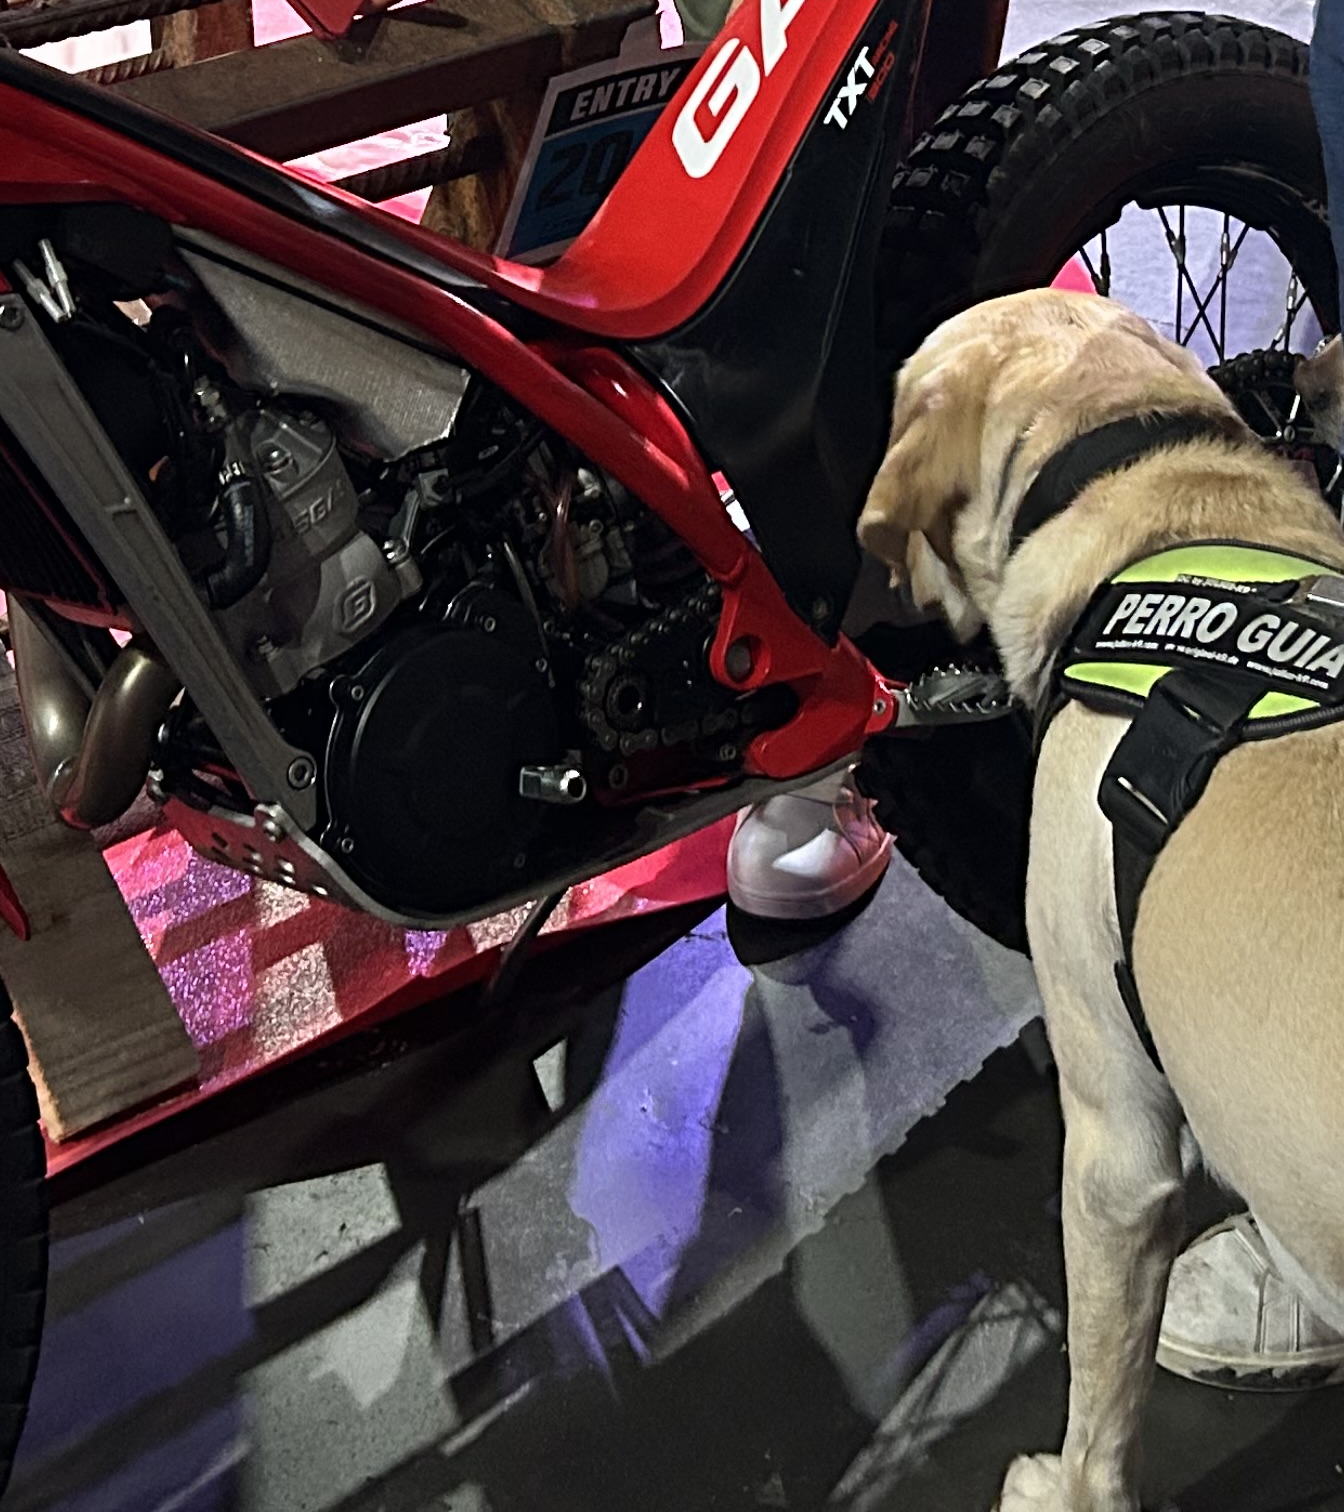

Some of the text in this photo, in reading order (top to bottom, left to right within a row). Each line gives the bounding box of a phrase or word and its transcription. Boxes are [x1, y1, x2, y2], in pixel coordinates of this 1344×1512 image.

[569, 67, 683, 121] ENTRY
[822, 45, 876, 130] TXT
[1102, 593, 1239, 644] PERRO
